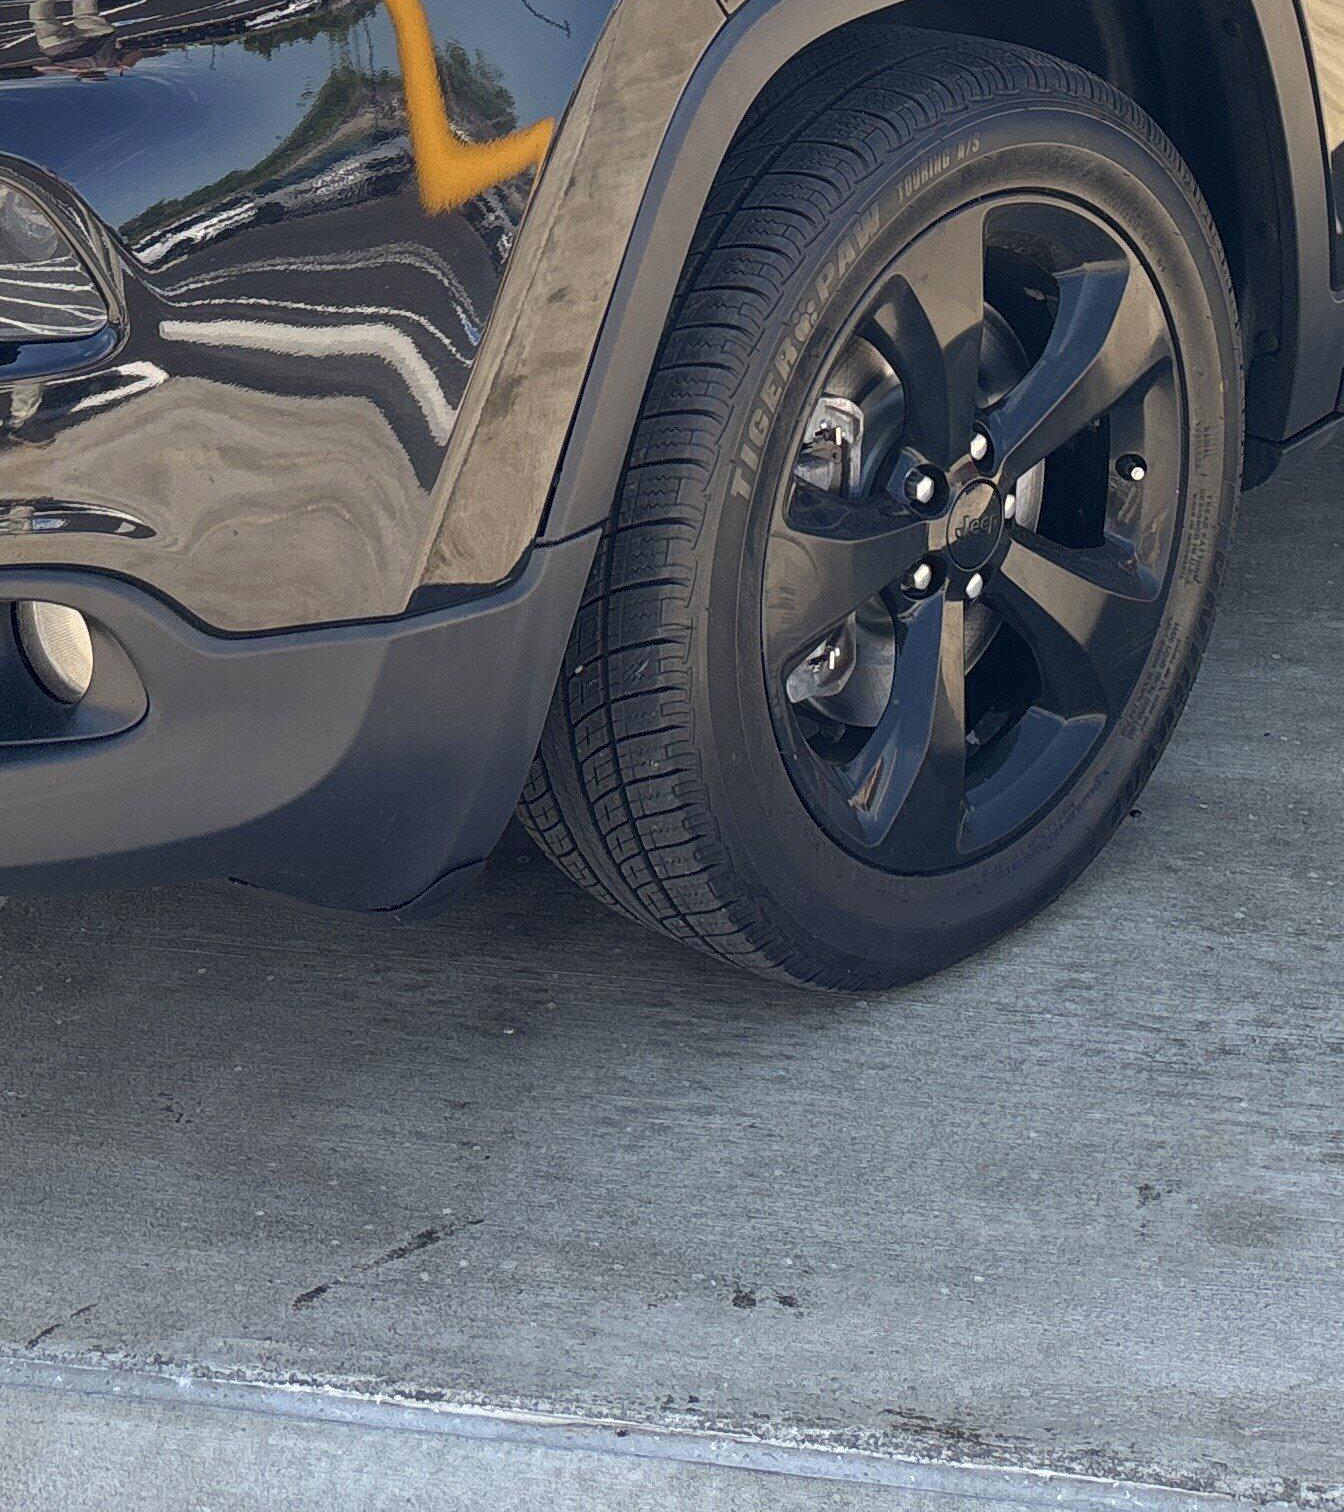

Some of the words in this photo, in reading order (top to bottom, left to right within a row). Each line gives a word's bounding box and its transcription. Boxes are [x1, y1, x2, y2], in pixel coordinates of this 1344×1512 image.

[730, 337, 798, 502] TIGER
[816, 199, 880, 305] PAW
[898, 148, 950, 204] TOURING
